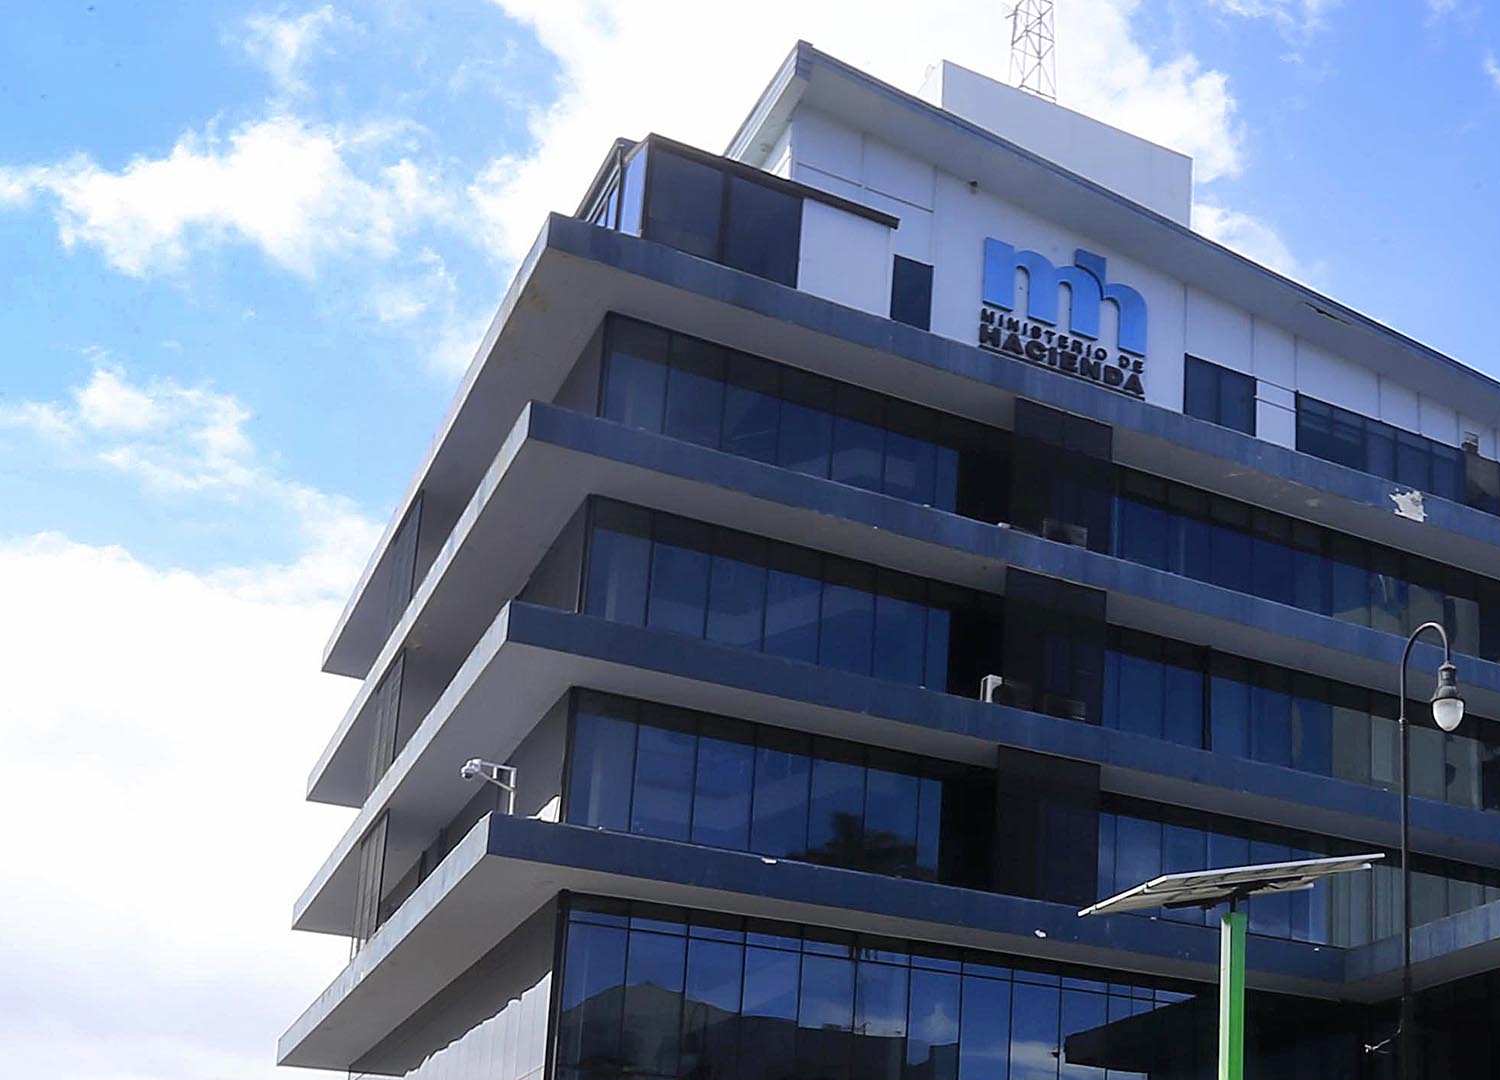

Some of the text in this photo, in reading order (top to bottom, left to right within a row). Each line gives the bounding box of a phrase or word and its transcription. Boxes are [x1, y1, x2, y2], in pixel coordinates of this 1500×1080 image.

[978, 323, 1145, 395] HACIENDA
[980, 307, 1145, 374] MINISTERIO DE
